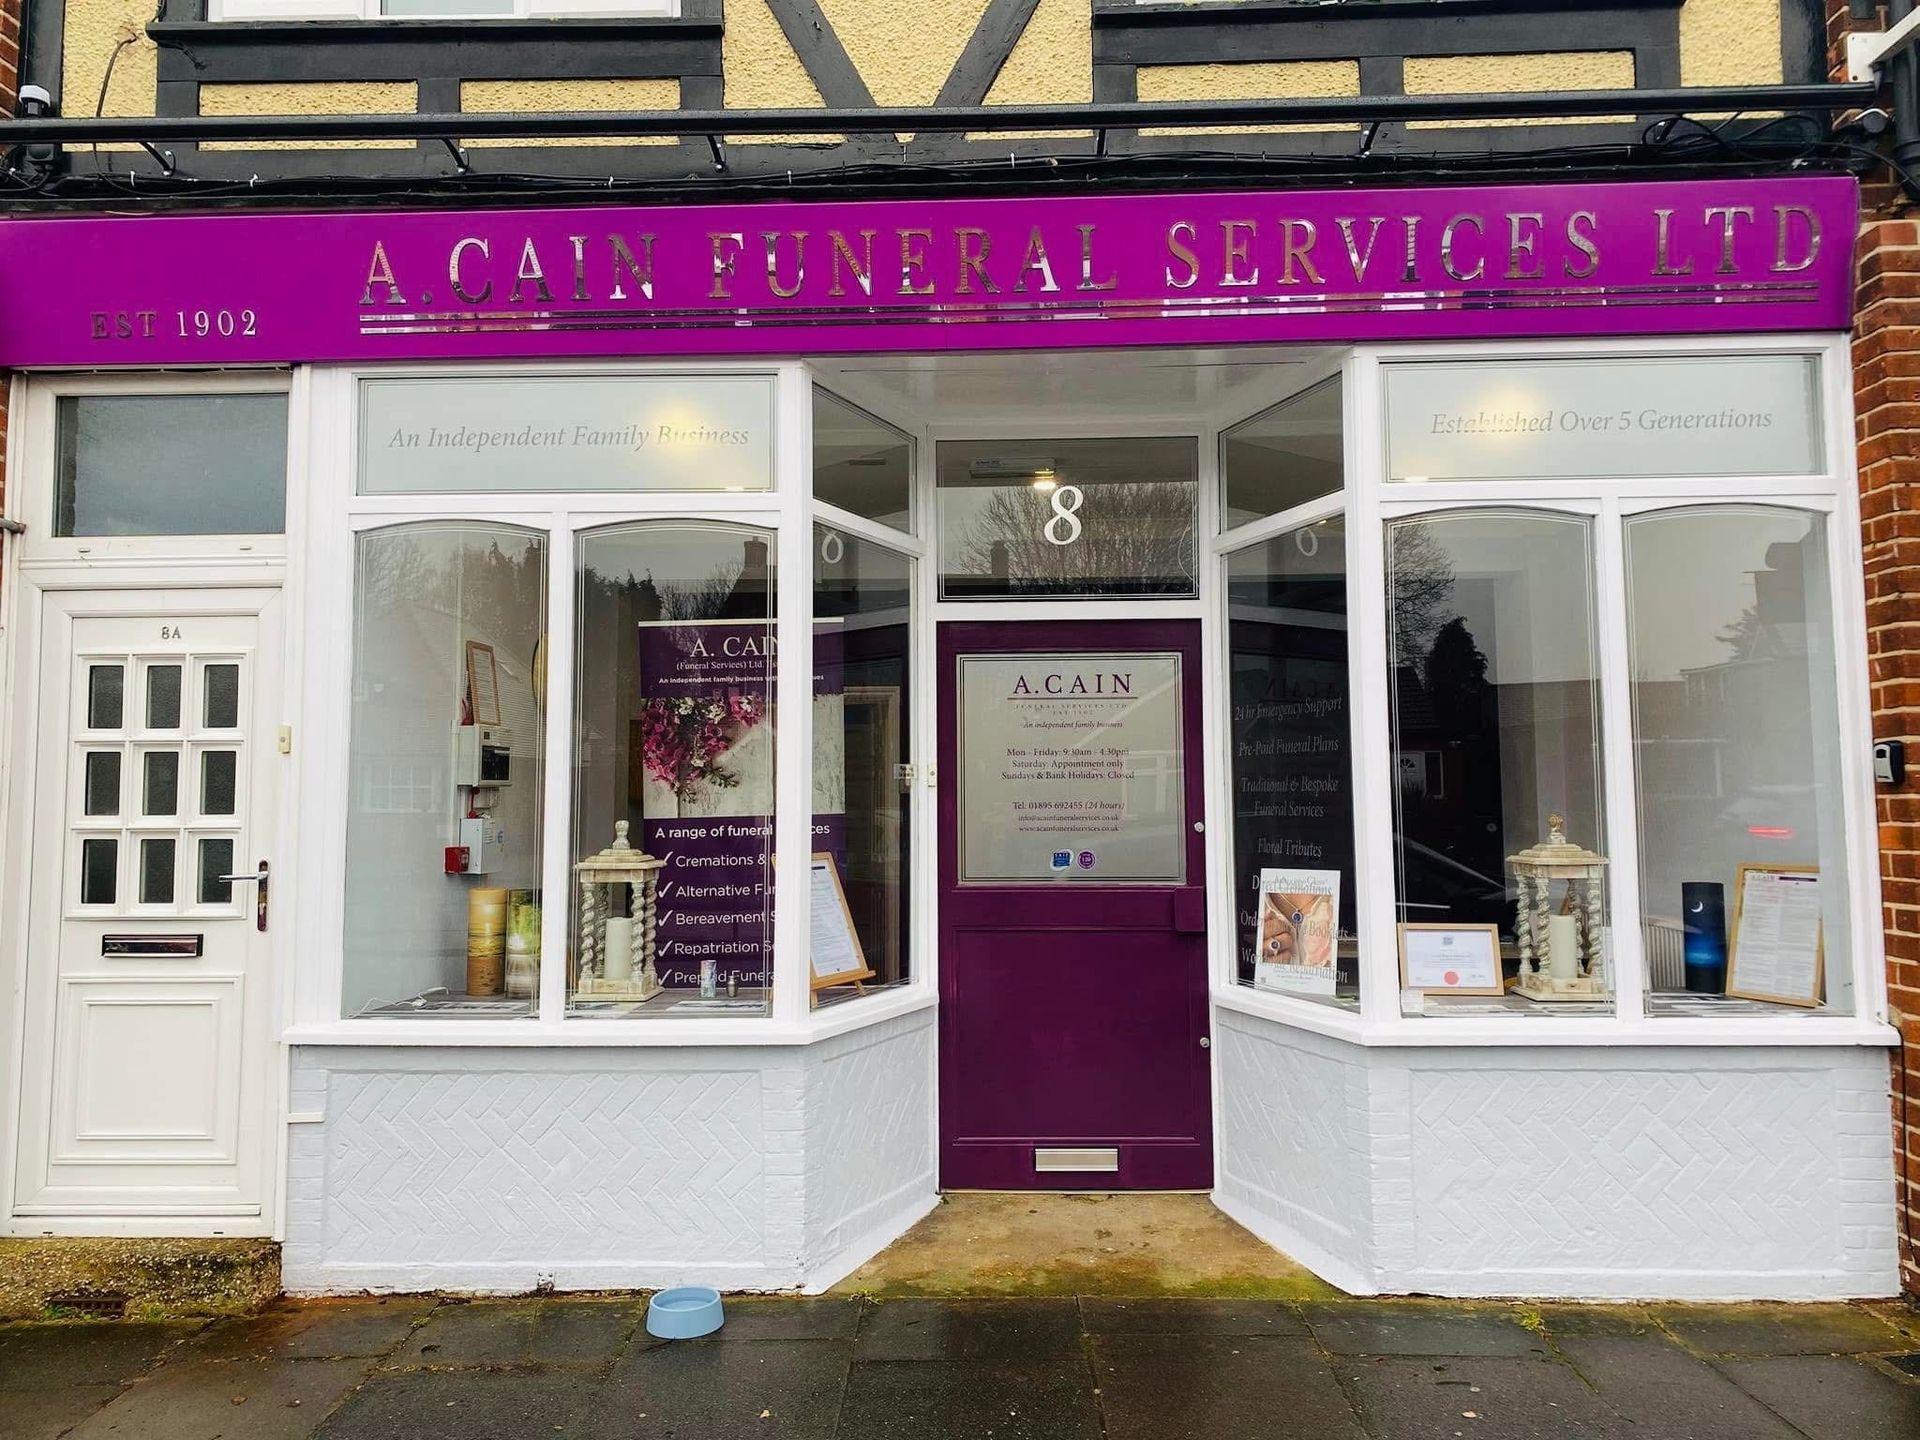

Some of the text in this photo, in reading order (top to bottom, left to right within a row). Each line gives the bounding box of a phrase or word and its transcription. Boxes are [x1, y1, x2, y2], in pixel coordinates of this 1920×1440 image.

[359, 204, 1822, 305] A.CAIN FUNERAL SERVICES LTD
[90, 310, 257, 339] EST 1902
[1431, 408, 1773, 435] Established Over 5 Generations
[388, 424, 750, 452] An Independent Family Business
[1044, 485, 1085, 546] 8
[160, 625, 182, 640] 8A
[689, 638, 716, 658] A.
[676, 660, 709, 672] (Funeral
[711, 660, 747, 671] Services)
[713, 675, 734, 685] family
[735, 675, 763, 683] business
[1012, 673, 1132, 694] A.CAIN
[1305, 697, 1342, 717] Support
[1024, 720, 1034, 728] An
[1007, 748, 1026, 757] Mon
[1276, 736, 1311, 755] Funeral
[1313, 734, 1340, 753] Plans
[1051, 759, 1105, 770] Appointment
[1106, 758, 1125, 770] only
[1002, 771, 1034, 781] Sundays
[1036, 771, 1045, 780] &
[1046, 771, 1067, 780] Bank
[1107, 770, 1135, 780] Closed
[1241, 775, 1289, 793] Traditional
[1301, 772, 1339, 797] Bespoke
[1028, 801, 1053, 810] 01895
[1054, 800, 1083, 810] 692455
[1254, 799, 1325, 818] Funeral Services
[655, 824, 774, 840] A range of funeral
[1257, 837, 1323, 858] Floral Tributes
[675, 853, 767, 867] Cremations &
[675, 884, 751, 897] Alternative
[1252, 874, 1278, 892] Drect
[675, 911, 766, 926] Bereavement
[674, 940, 759, 957] Repatriation
